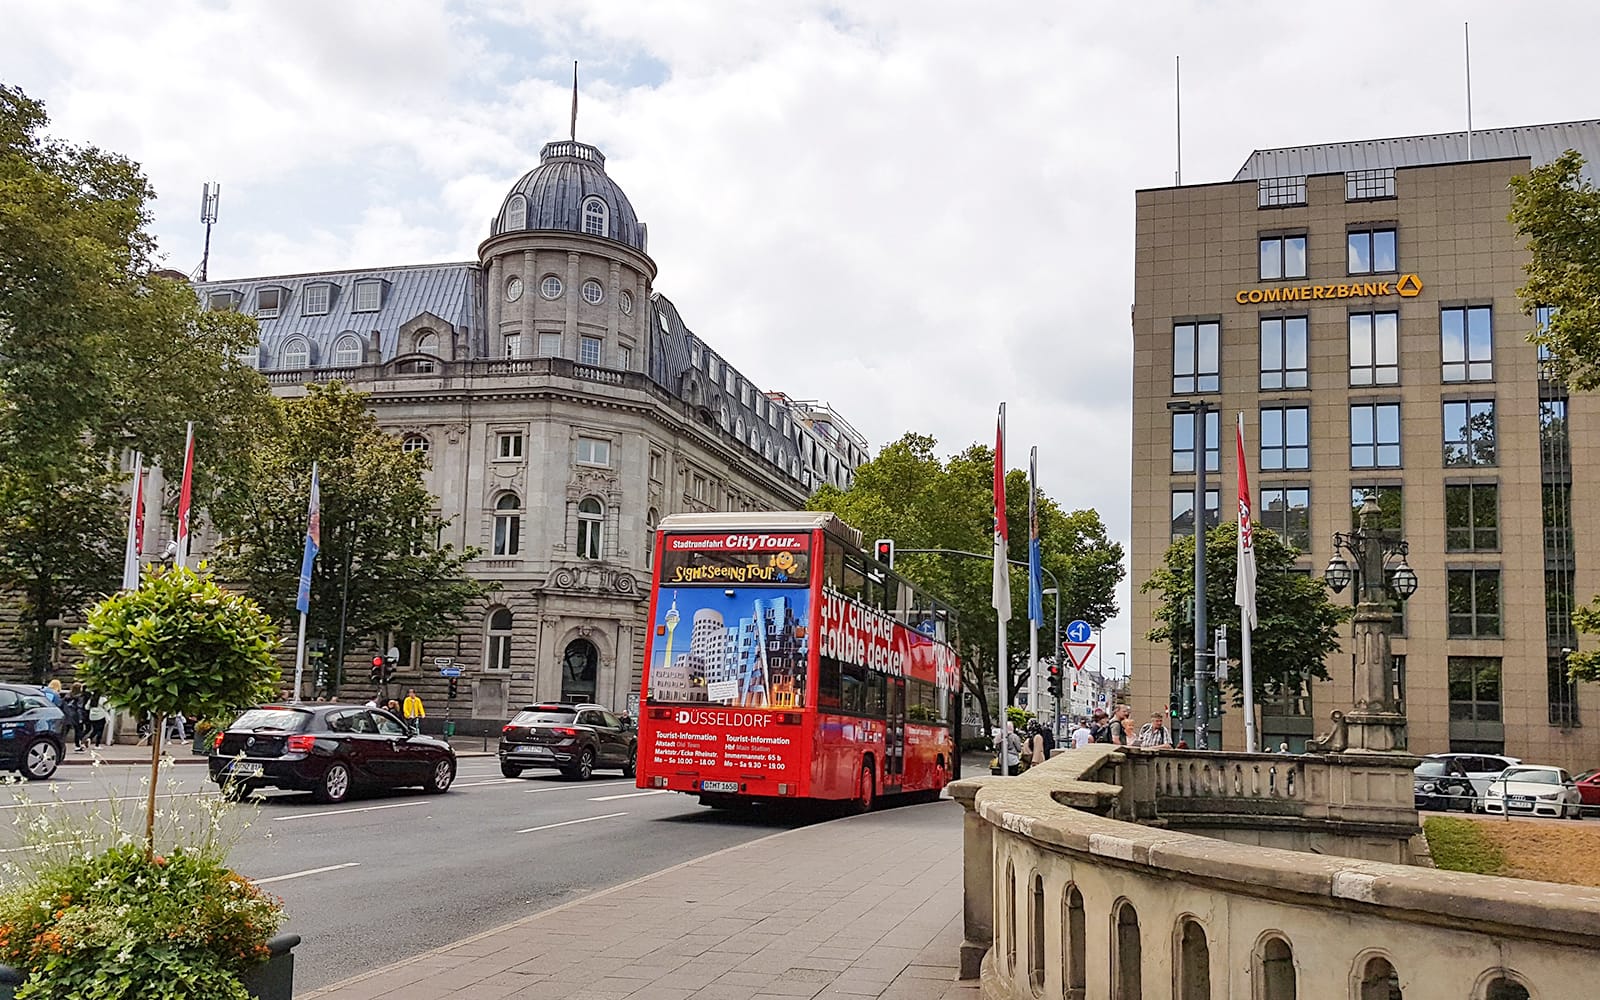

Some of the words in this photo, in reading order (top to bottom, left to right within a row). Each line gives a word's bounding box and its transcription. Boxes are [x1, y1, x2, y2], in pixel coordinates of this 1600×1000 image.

[1236, 281, 1391, 304] COMMERZBANK
[673, 540, 723, 549] Stadtrundfahrt
[849, 592, 894, 642] checker
[820, 613, 865, 666] double
[867, 631, 904, 677] decker
[656, 731, 717, 741] Tourist-Information
[726, 734, 790, 745] Tourist-Information
